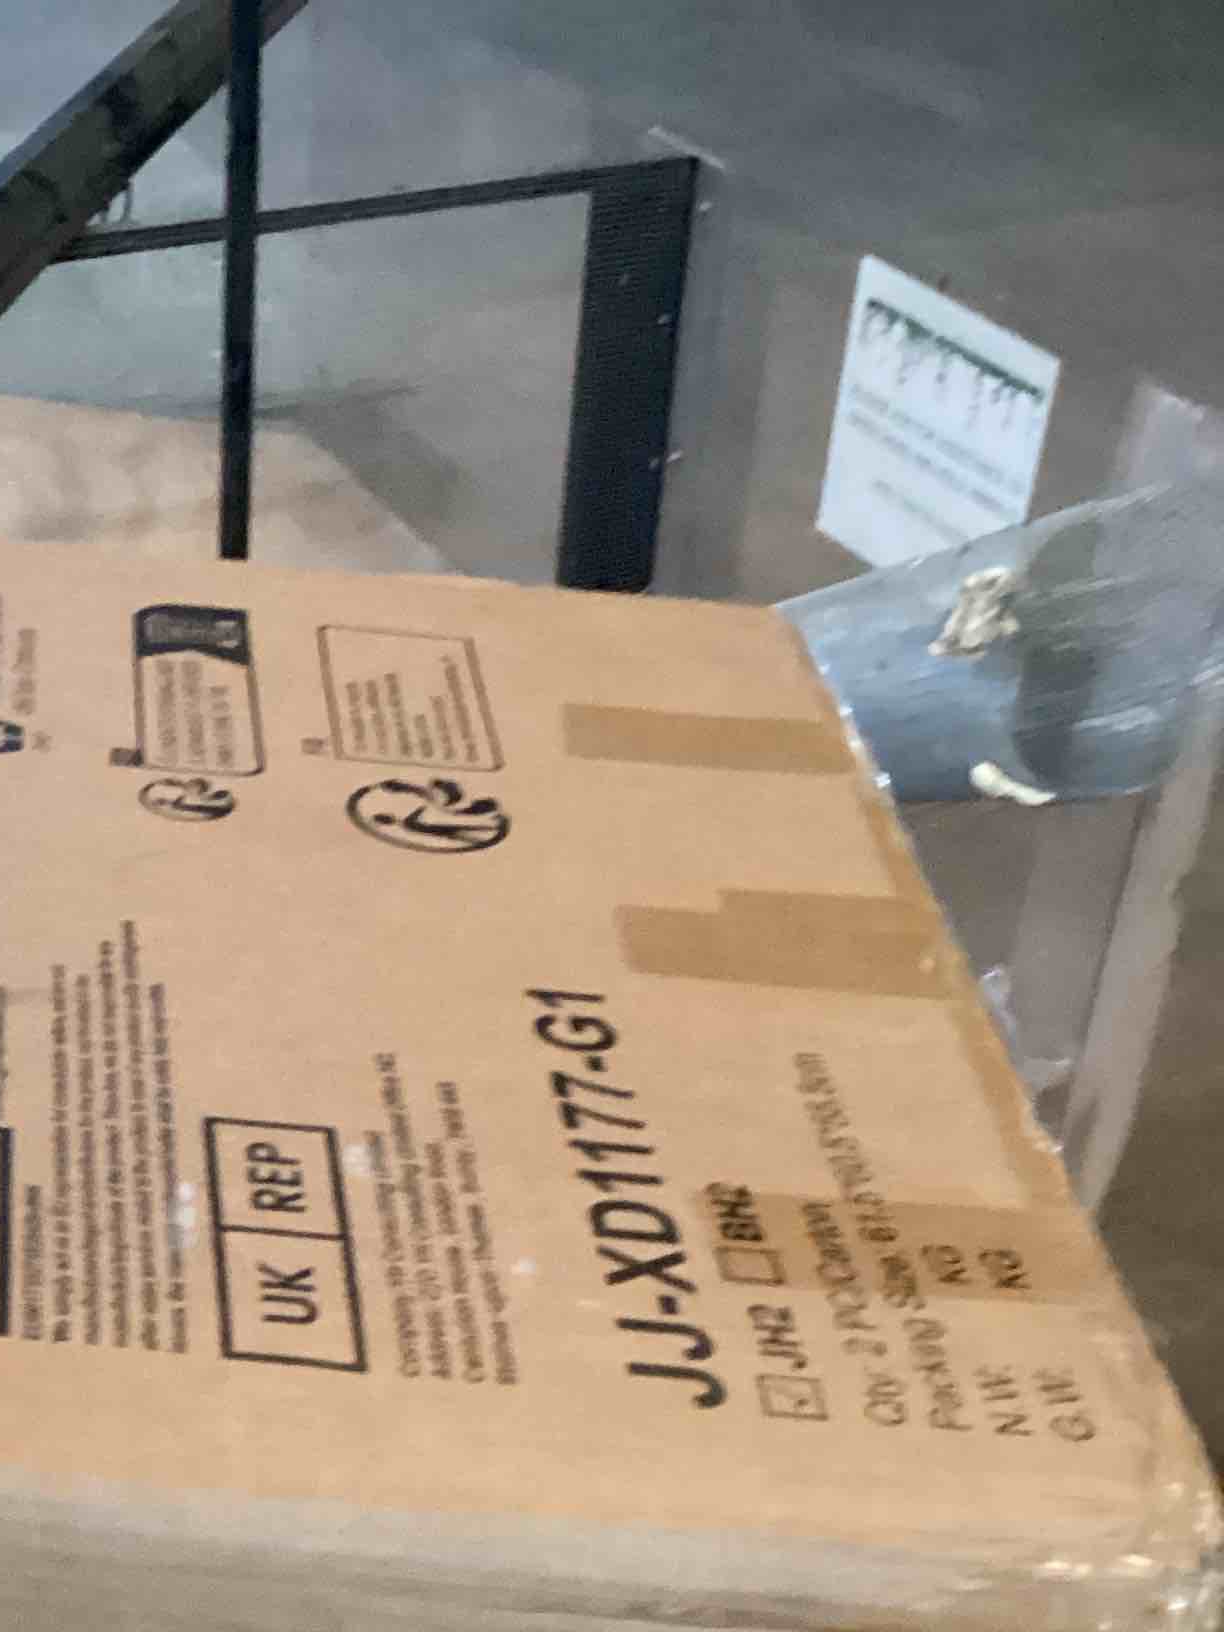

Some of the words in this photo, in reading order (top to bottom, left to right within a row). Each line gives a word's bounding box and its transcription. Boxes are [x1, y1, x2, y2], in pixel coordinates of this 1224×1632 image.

[246, 1141, 307, 1214] REP
[524, 987, 728, 1410] JJ-XD1177-G1
[702, 1181, 764, 1243] BH2
[255, 1261, 320, 1326] UK
[747, 1304, 808, 1372] JH2
